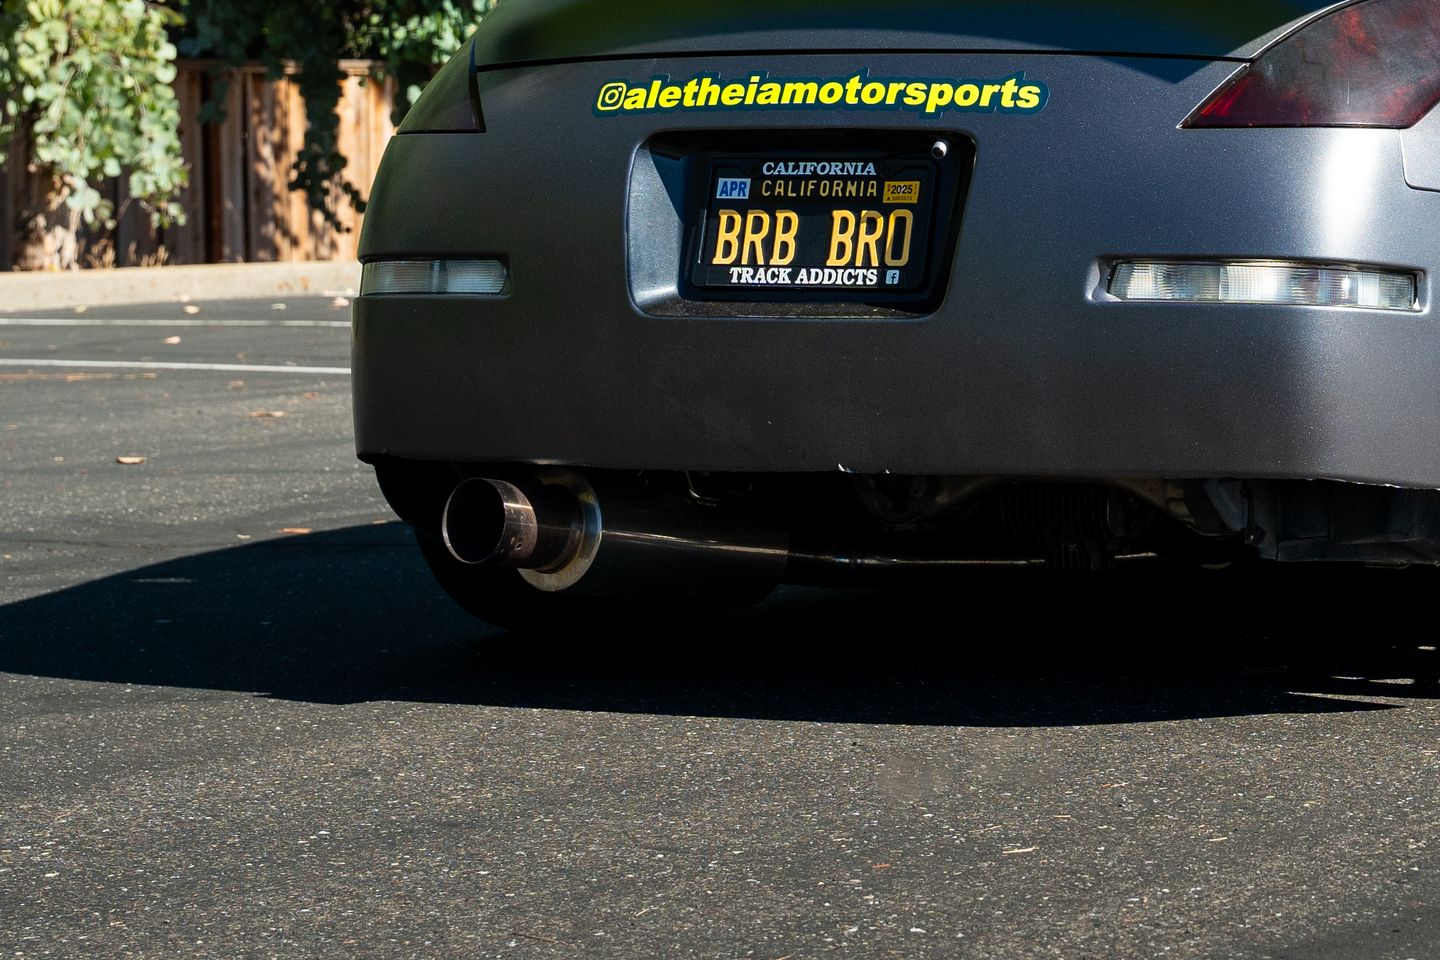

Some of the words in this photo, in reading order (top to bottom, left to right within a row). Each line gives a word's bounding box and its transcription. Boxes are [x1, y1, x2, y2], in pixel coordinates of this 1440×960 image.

[762, 161, 877, 176] CALIFORNIA
[719, 181, 748, 198] APR
[761, 179, 878, 198] CALIFORNIA
[891, 184, 913, 194] 2025
[712, 209, 799, 266] BRB
[826, 209, 914, 267] BRO
[729, 267, 792, 285] TRACK
[795, 268, 878, 286] ADDICTS
